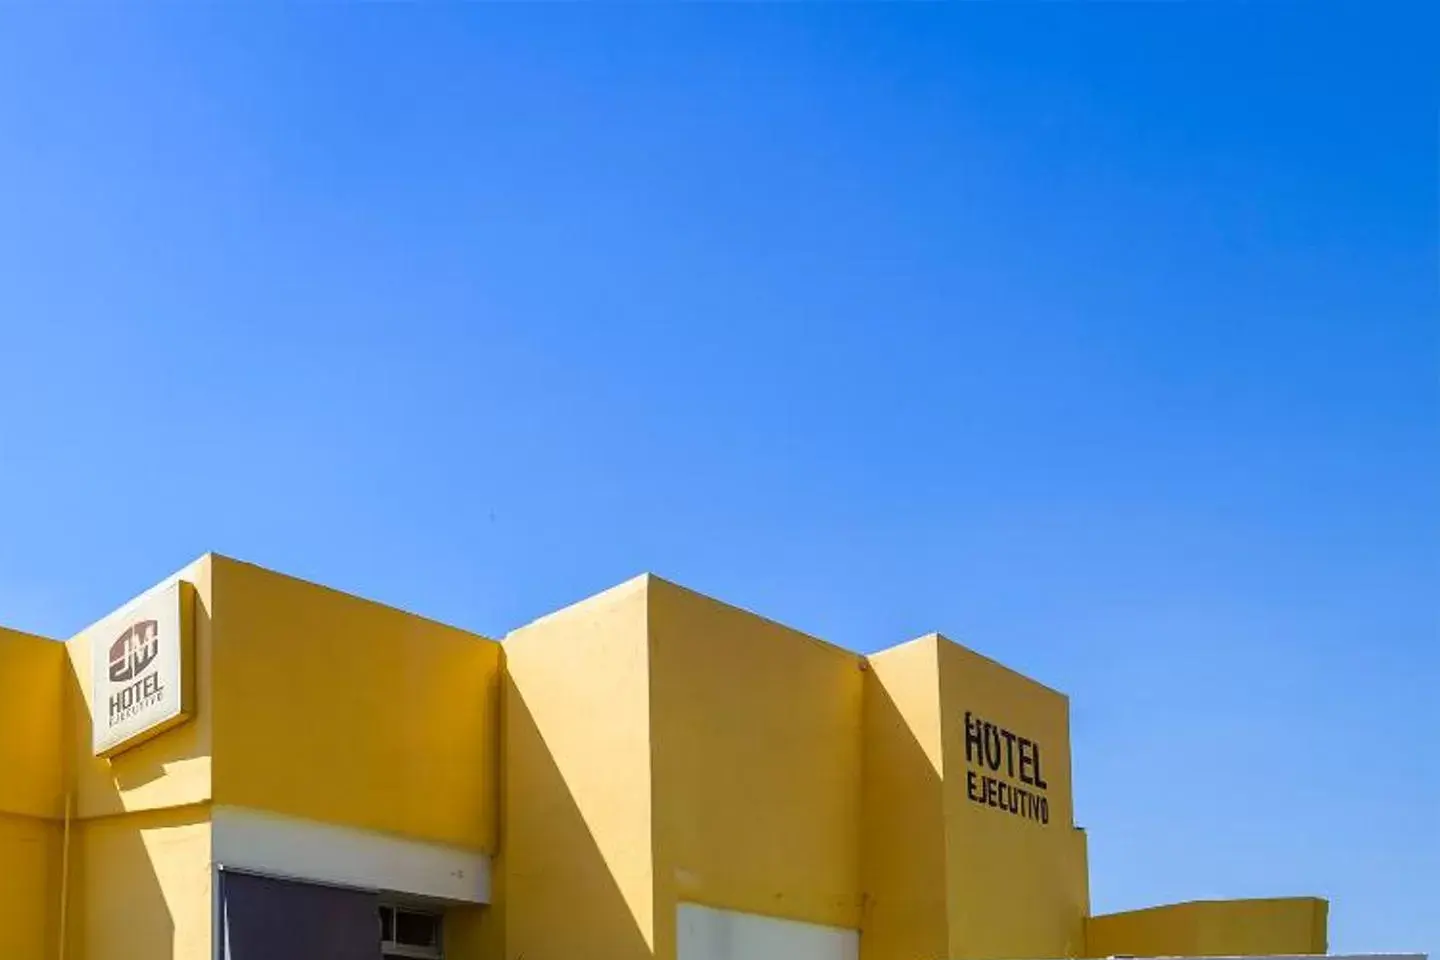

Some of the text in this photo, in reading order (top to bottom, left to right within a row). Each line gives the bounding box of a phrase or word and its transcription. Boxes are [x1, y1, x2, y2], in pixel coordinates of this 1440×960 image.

[114, 623, 155, 677] JM
[109, 671, 164, 717] HOTEL
[965, 711, 1047, 790] HOTEL
[967, 770, 1049, 824] EJECUTIVO
